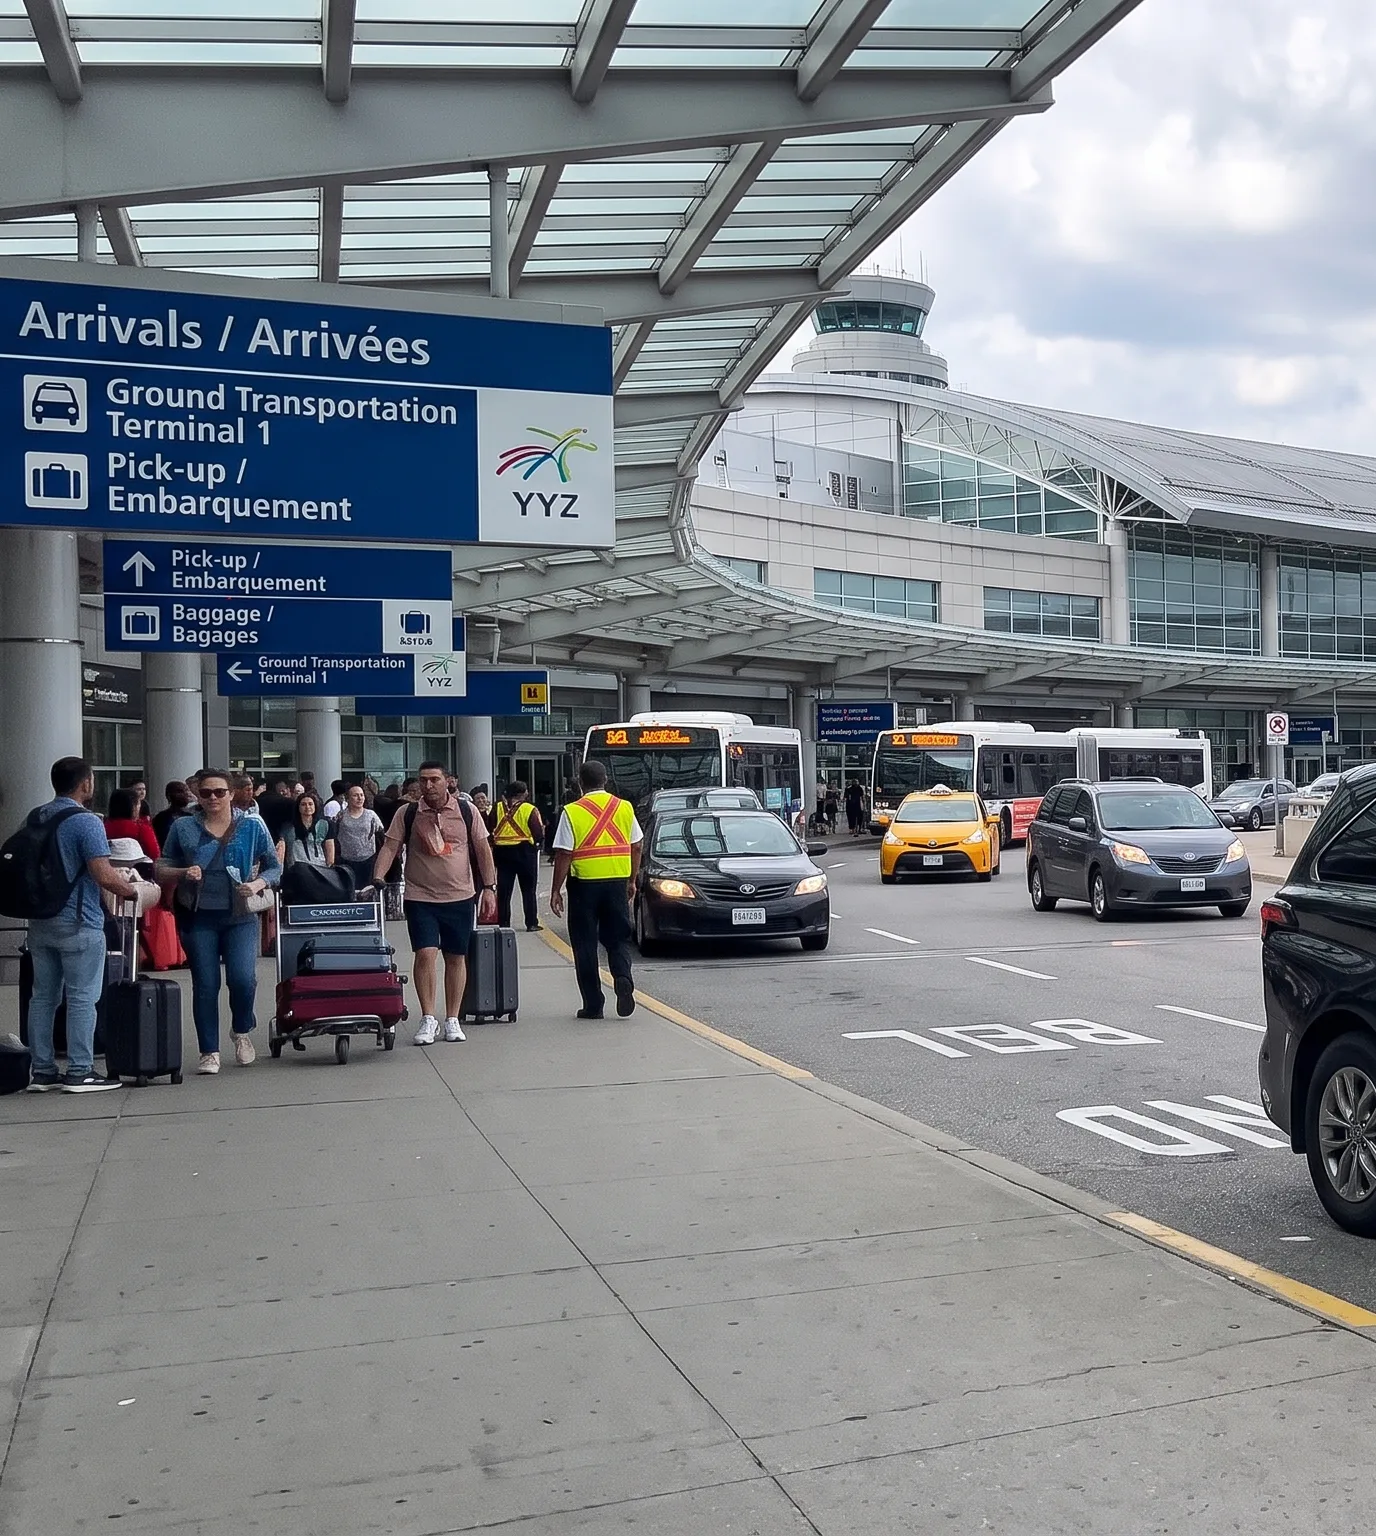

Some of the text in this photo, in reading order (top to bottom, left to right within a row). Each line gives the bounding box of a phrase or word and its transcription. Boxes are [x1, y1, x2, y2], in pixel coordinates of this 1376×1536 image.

[19, 301, 431, 366] Arrivals / Arrivées
[106, 379, 457, 425] Ground Transportation
[107, 411, 270, 446] Terminal 1
[108, 452, 247, 489] Pick-up /
[108, 485, 352, 522] Embarquement
[512, 491, 580, 519] YYZ
[172, 549, 260, 571] Pick-up /
[172, 570, 326, 594] Embarquement
[173, 603, 274, 625] Baggage /
[173, 626, 259, 647] Bagages
[258, 655, 406, 672] Ground Transportation
[259, 671, 328, 684] Terminal 1
[426, 677, 452, 687] YYZ
